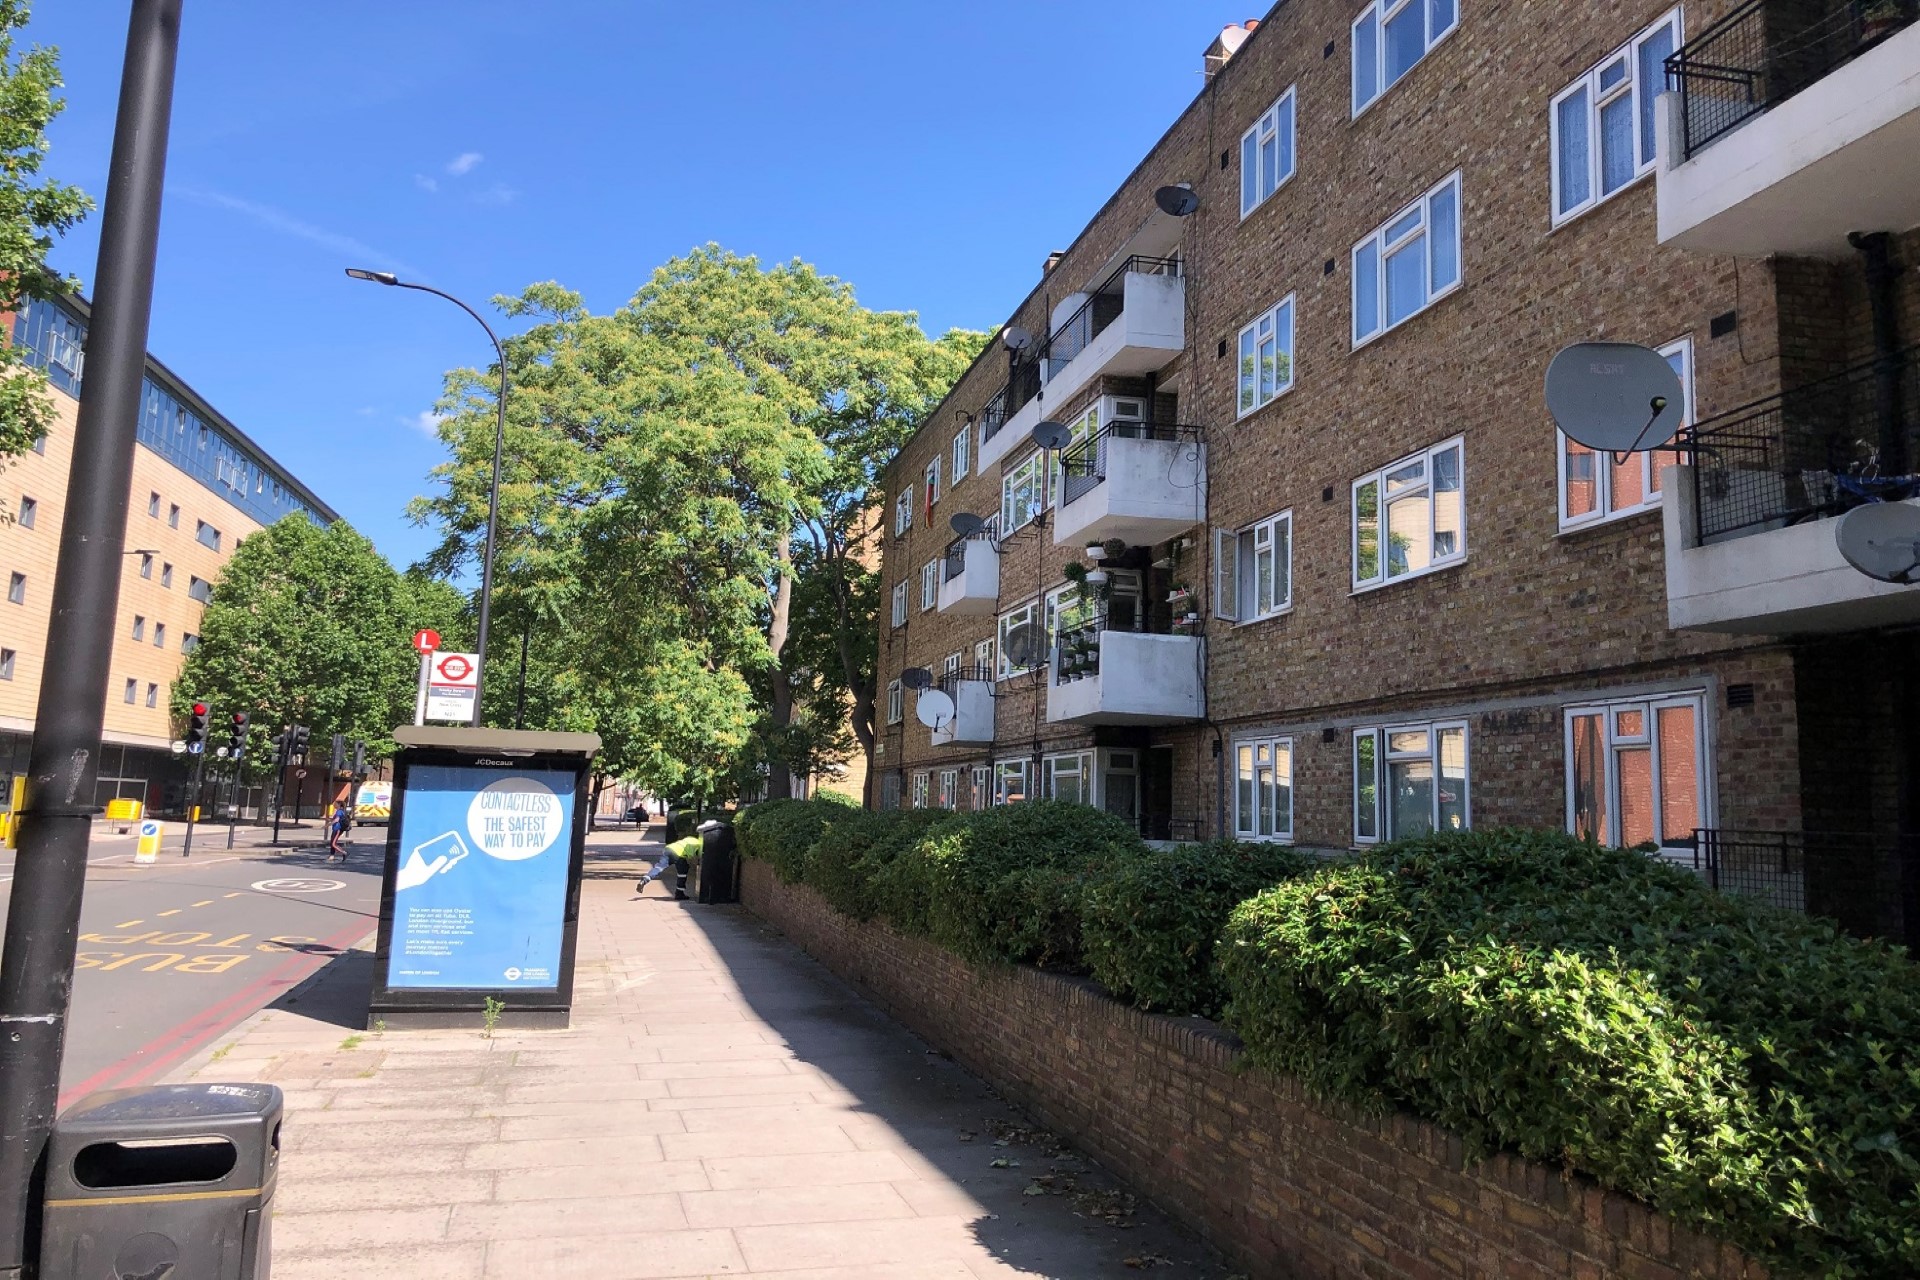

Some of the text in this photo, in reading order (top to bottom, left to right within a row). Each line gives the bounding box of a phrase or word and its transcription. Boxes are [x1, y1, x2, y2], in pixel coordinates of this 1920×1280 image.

[421, 633, 432, 648] L
[475, 758, 513, 766] JCDecaux
[481, 791, 551, 813] CONTACTLESS
[484, 816, 547, 831] THE SAFEST
[484, 832, 546, 848] WAY TO PAY
